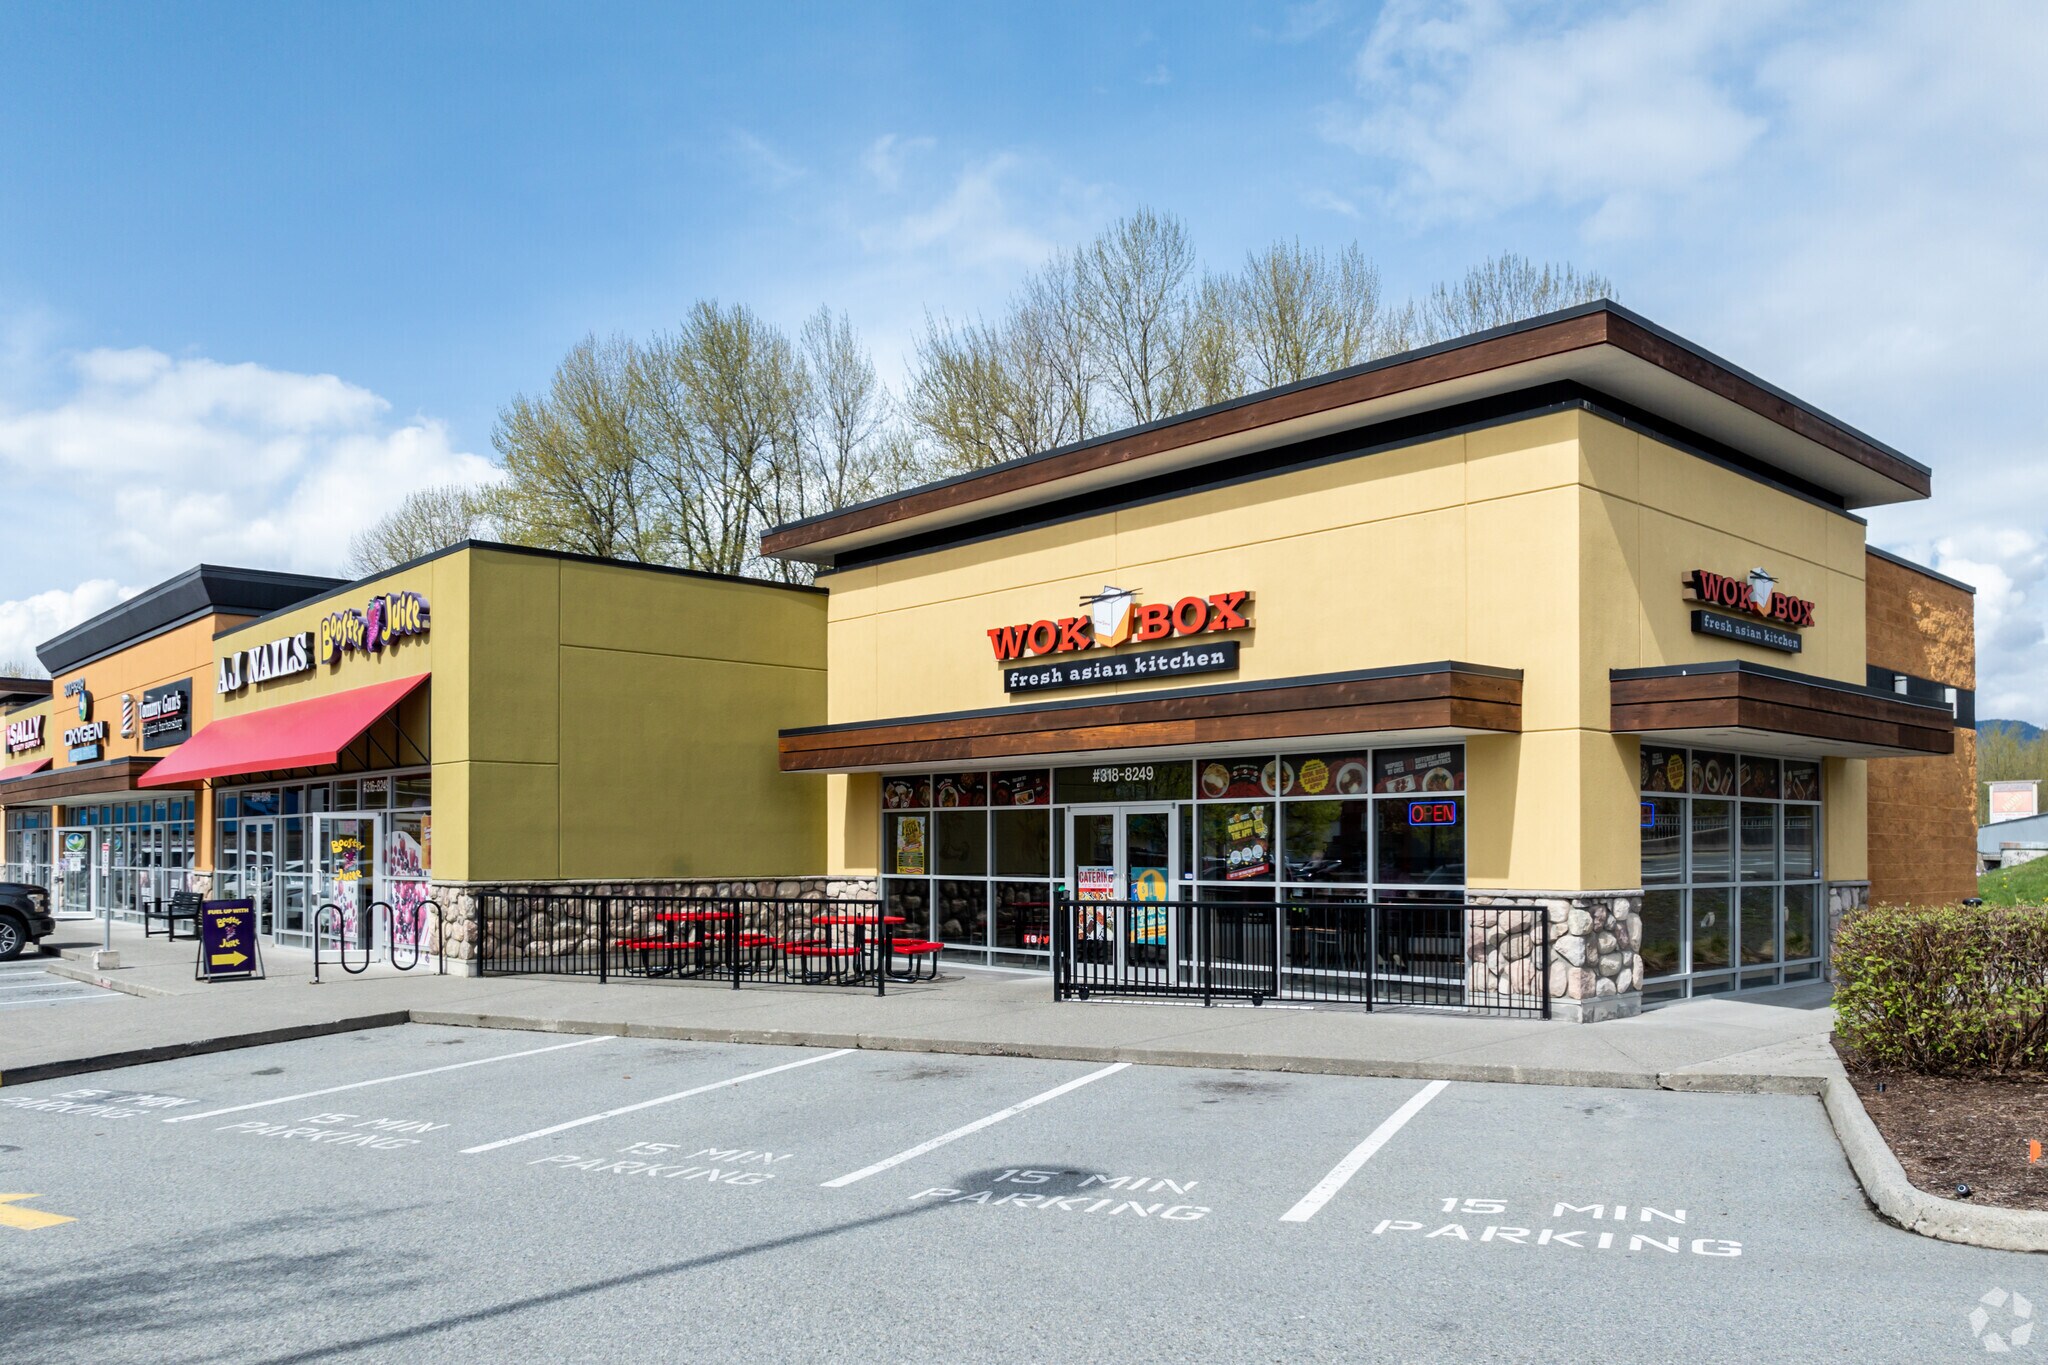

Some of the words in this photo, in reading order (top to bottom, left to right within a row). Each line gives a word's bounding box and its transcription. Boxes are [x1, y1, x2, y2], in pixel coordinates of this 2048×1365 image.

[1700, 570, 1754, 610] WOK
[1774, 592, 1815, 626] BOX
[321, 610, 366, 662] Booster
[381, 592, 421, 643] Juice
[987, 615, 1094, 660] WOK
[1137, 591, 1249, 641] BOX
[1704, 615, 1732, 633] fresh
[1735, 625, 1762, 640] asian
[1764, 630, 1799, 648] kitchen
[217, 651, 242, 694] AJ
[1010, 668, 1063, 688] fresh
[1069, 662, 1128, 681] asian
[1134, 651, 1225, 673] kitchen
[138, 701, 162, 719] Tommy
[163, 690, 181, 713] Gun's
[10, 715, 41, 745] SALLY
[64, 721, 103, 747] OXYGEN
[1092, 765, 1154, 783] #318-8249
[1411, 804, 1454, 822] OPEN
[330, 838, 365, 854] Booster
[334, 868, 363, 881] Juice
[216, 916, 242, 928] Booster
[219, 938, 240, 948] Juice
[1, 1097, 150, 1118] PARKING
[215, 1121, 421, 1149] PARKING
[297, 1113, 360, 1124] 15
[353, 1118, 450, 1133] MIN
[618, 1142, 681, 1155] 15
[684, 1148, 794, 1165] MIN
[527, 1154, 775, 1184] PARKING
[993, 1169, 1059, 1184] 15
[1077, 1174, 1199, 1195] MIN
[908, 1187, 1212, 1221] PARKING
[1441, 1197, 1508, 1214] 15
[1552, 1202, 1686, 1224] MIN
[1372, 1219, 1743, 1257] PARKING
